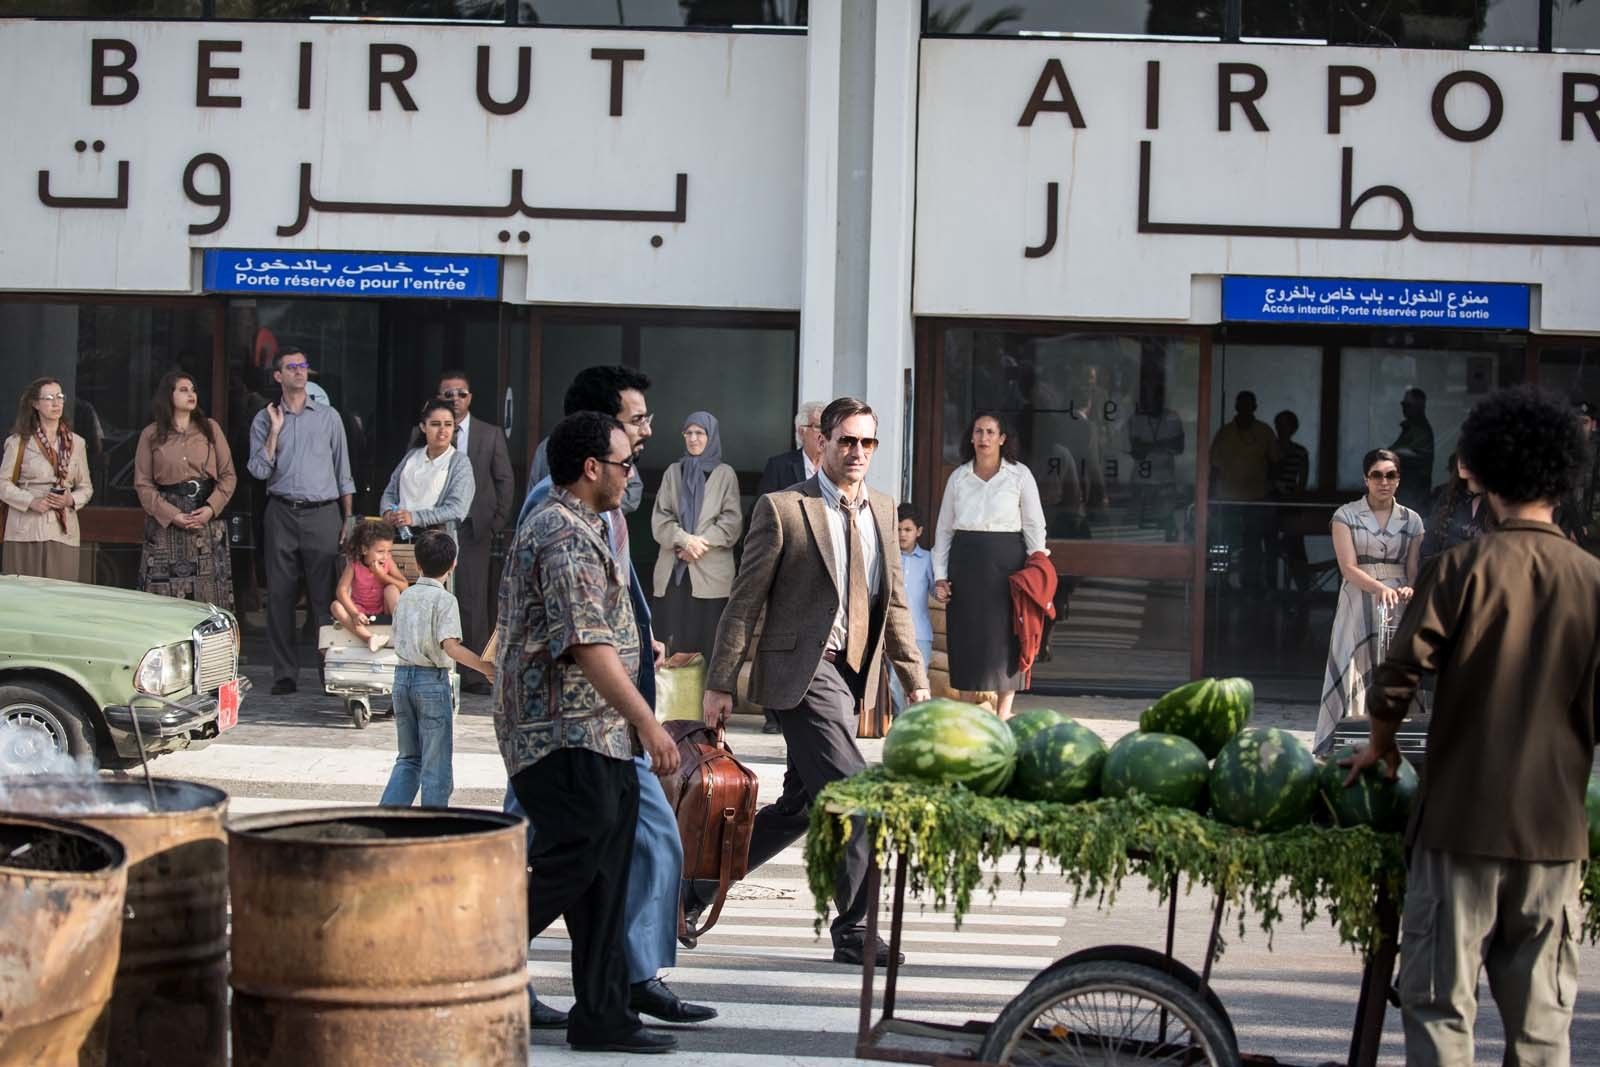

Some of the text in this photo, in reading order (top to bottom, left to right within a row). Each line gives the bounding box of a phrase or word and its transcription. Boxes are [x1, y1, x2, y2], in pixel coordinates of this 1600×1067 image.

[91, 39, 645, 116] BEIRUT
[38, 140, 687, 248] بيروت
[1025, 141, 1600, 258] طار
[234, 257, 469, 277] باب خاص بالدخول
[236, 273, 280, 286] Porte
[284, 275, 356, 288] réservée
[360, 278, 400, 291] pour
[1265, 285, 1316, 304] بالخروج
[1319, 287, 1356, 303] خاص
[1360, 288, 1384, 304] باب
[1399, 288, 1443, 306] الدخول
[1447, 290, 1489, 309] ممنوع
[1341, 305, 1370, 316] Porte
[1372, 306, 1418, 317] réservée
[1420, 308, 1445, 319] pour
[1447, 308, 1457, 318] la
[1459, 309, 1490, 319] sortie
